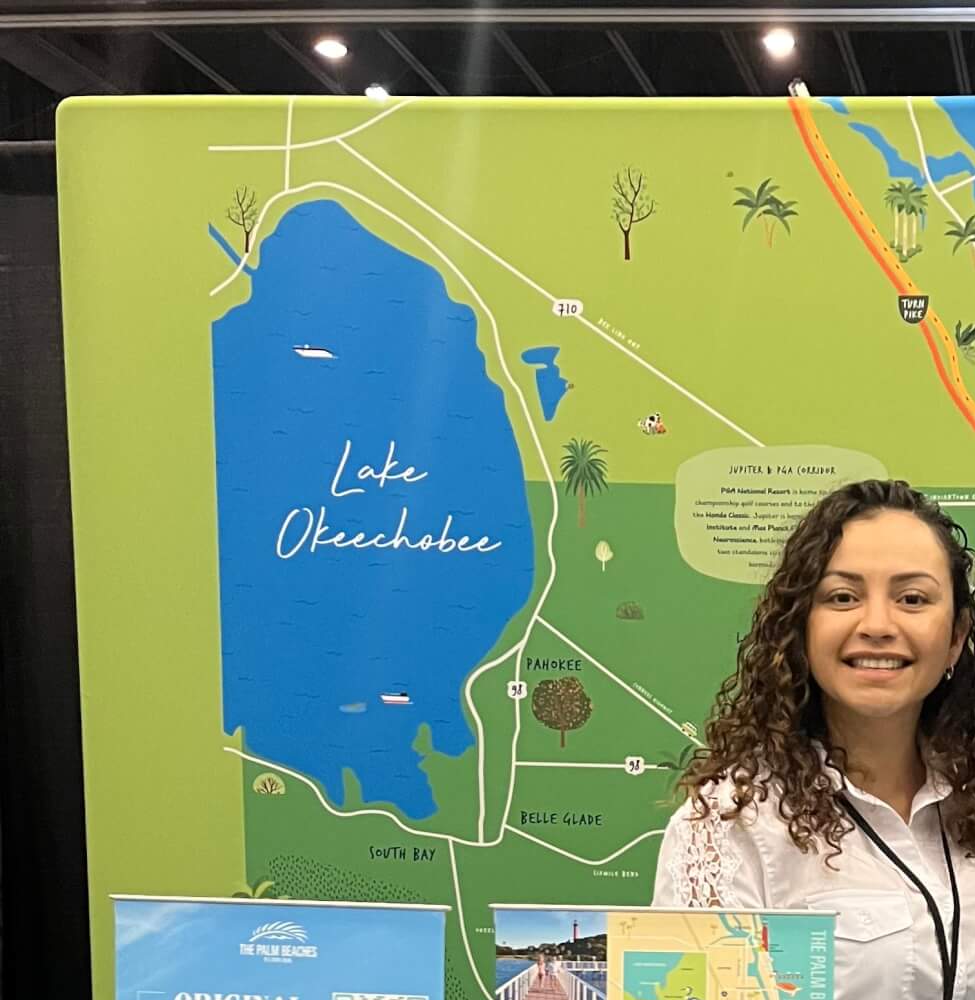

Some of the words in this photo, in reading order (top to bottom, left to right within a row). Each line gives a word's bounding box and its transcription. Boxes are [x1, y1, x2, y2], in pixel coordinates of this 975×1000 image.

[558, 303, 578, 318] 710
[902, 299, 925, 310] TURN
[904, 310, 924, 320] PIKE
[331, 440, 428, 496] Lake
[729, 465, 764, 476] JUPITER
[777, 465, 794, 476] PGA
[797, 465, 836, 476] CORRIDOR
[277, 508, 502, 558] Okeechobee
[527, 658, 582, 672] PAHOKEE
[511, 684, 524, 696] 98
[629, 760, 640, 772] 98
[520, 811, 558, 826] BELLE
[562, 812, 602, 826] GLADE
[369, 846, 406, 860] SOUTH
[413, 847, 436, 862] BAY
[810, 930, 828, 954] THE
[240, 943, 256, 956] THE
[256, 944, 280, 958] PALM
[281, 945, 318, 958] BEACHES
[810, 955, 828, 990] PALM
